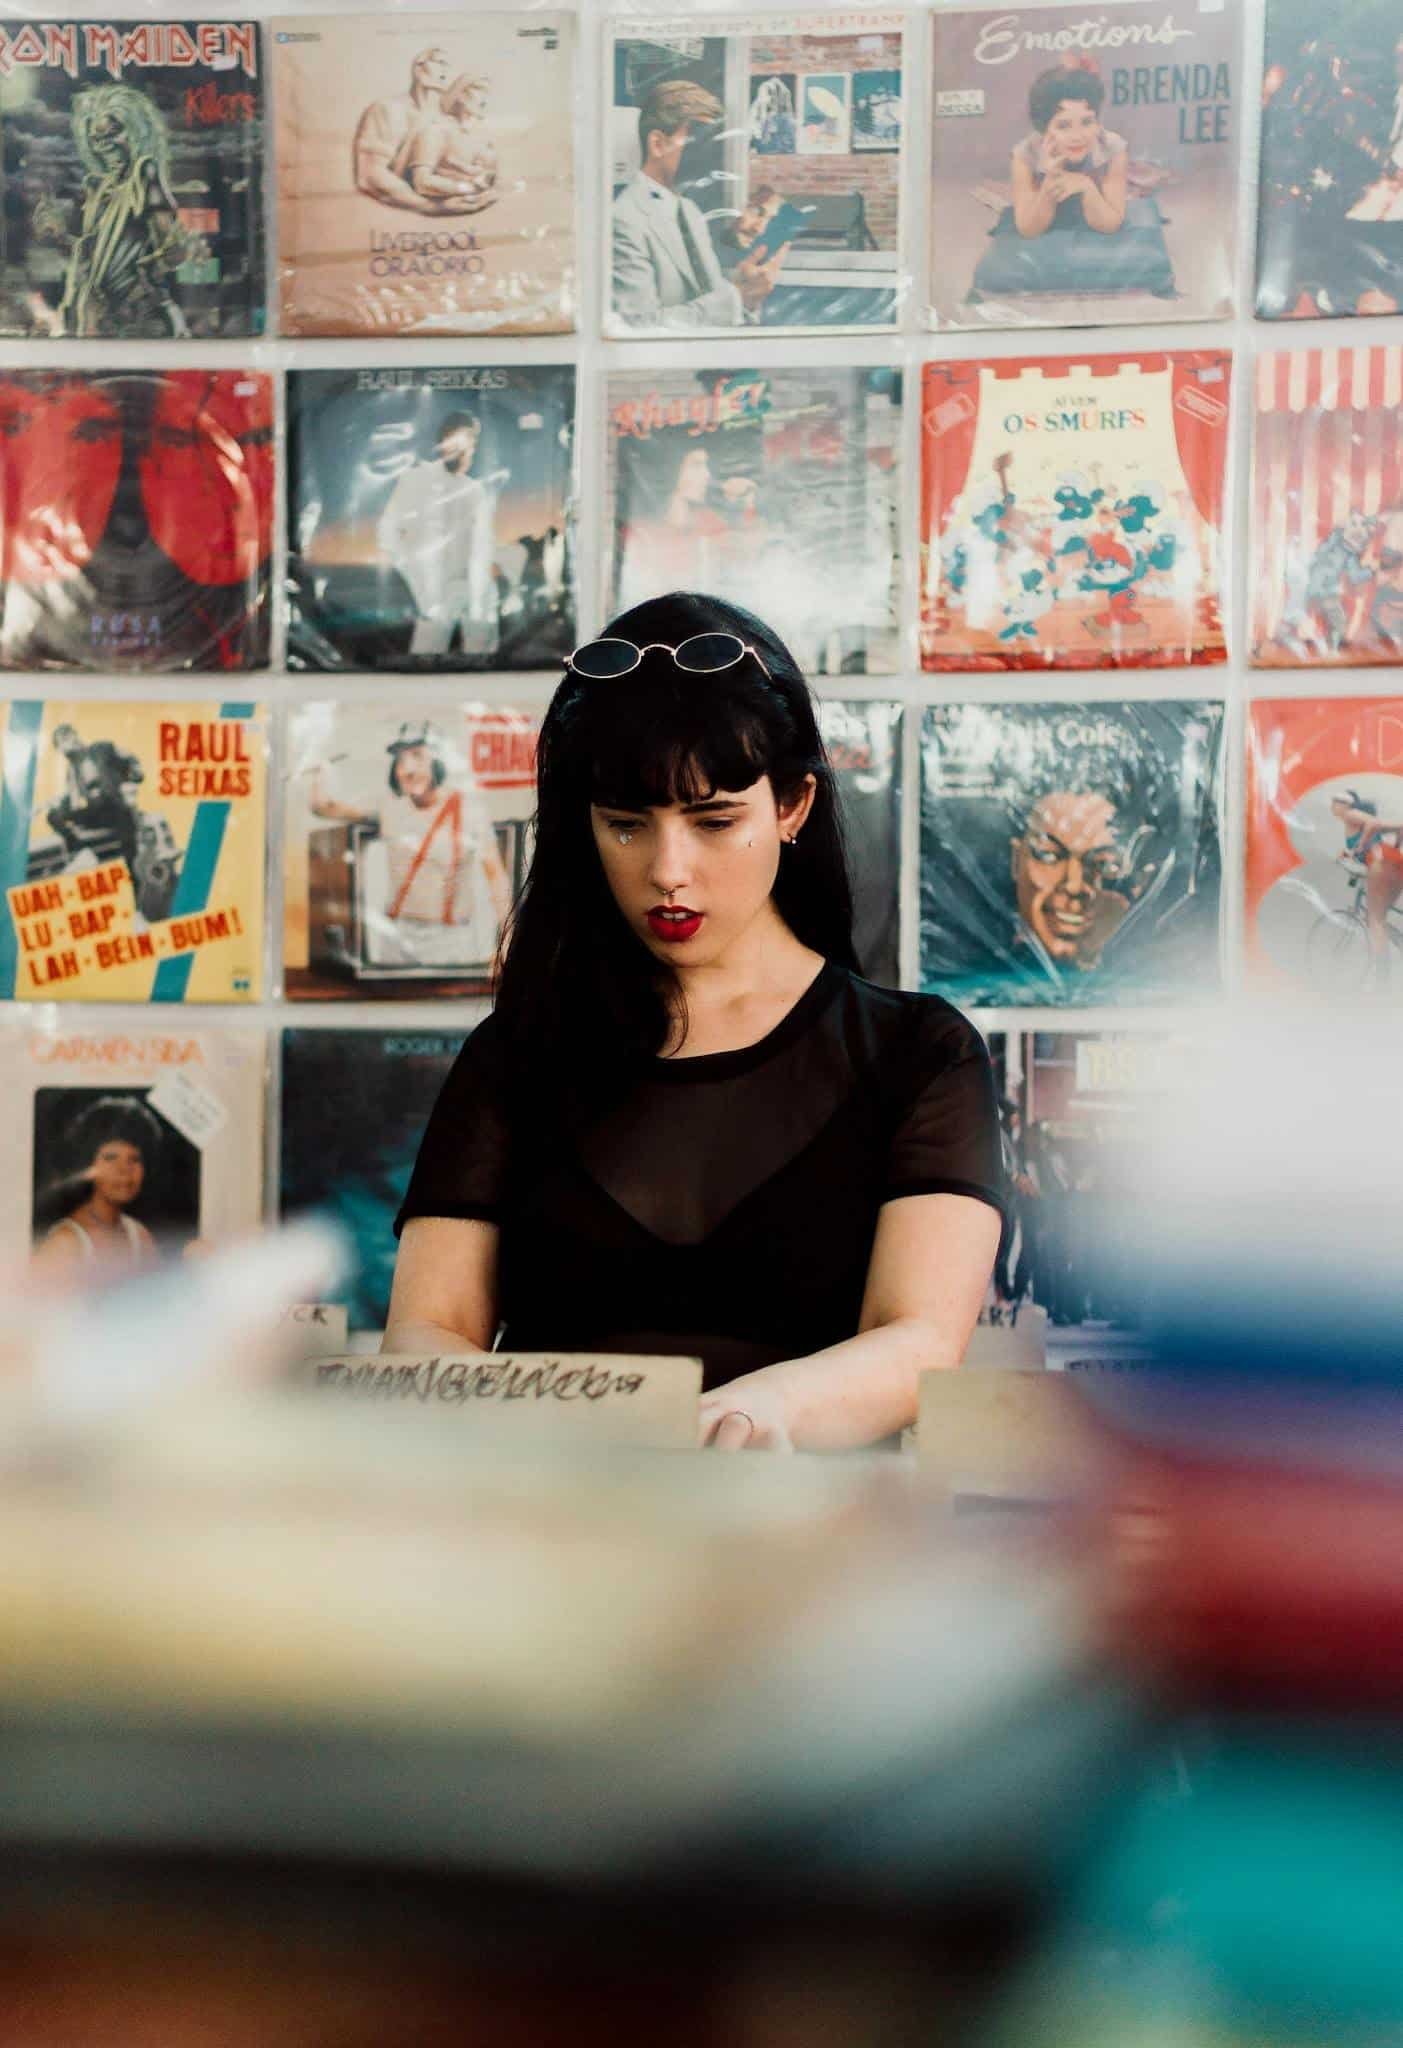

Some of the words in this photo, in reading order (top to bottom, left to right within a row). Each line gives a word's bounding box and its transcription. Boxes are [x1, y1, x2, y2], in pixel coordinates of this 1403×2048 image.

[82, 24, 257, 80] MAIDEN
[974, 15, 1196, 65] Emotions
[1111, 62, 1231, 106] BRENDA
[1178, 105, 1231, 145] LEE
[369, 229, 482, 256] LIVERPOOL
[369, 255, 485, 277] ORATORIO
[1003, 412, 1038, 434] OS
[1044, 408, 1146, 432] SMURFS
[160, 723, 250, 762] RAUL
[160, 768, 250, 797] SEIXAS
